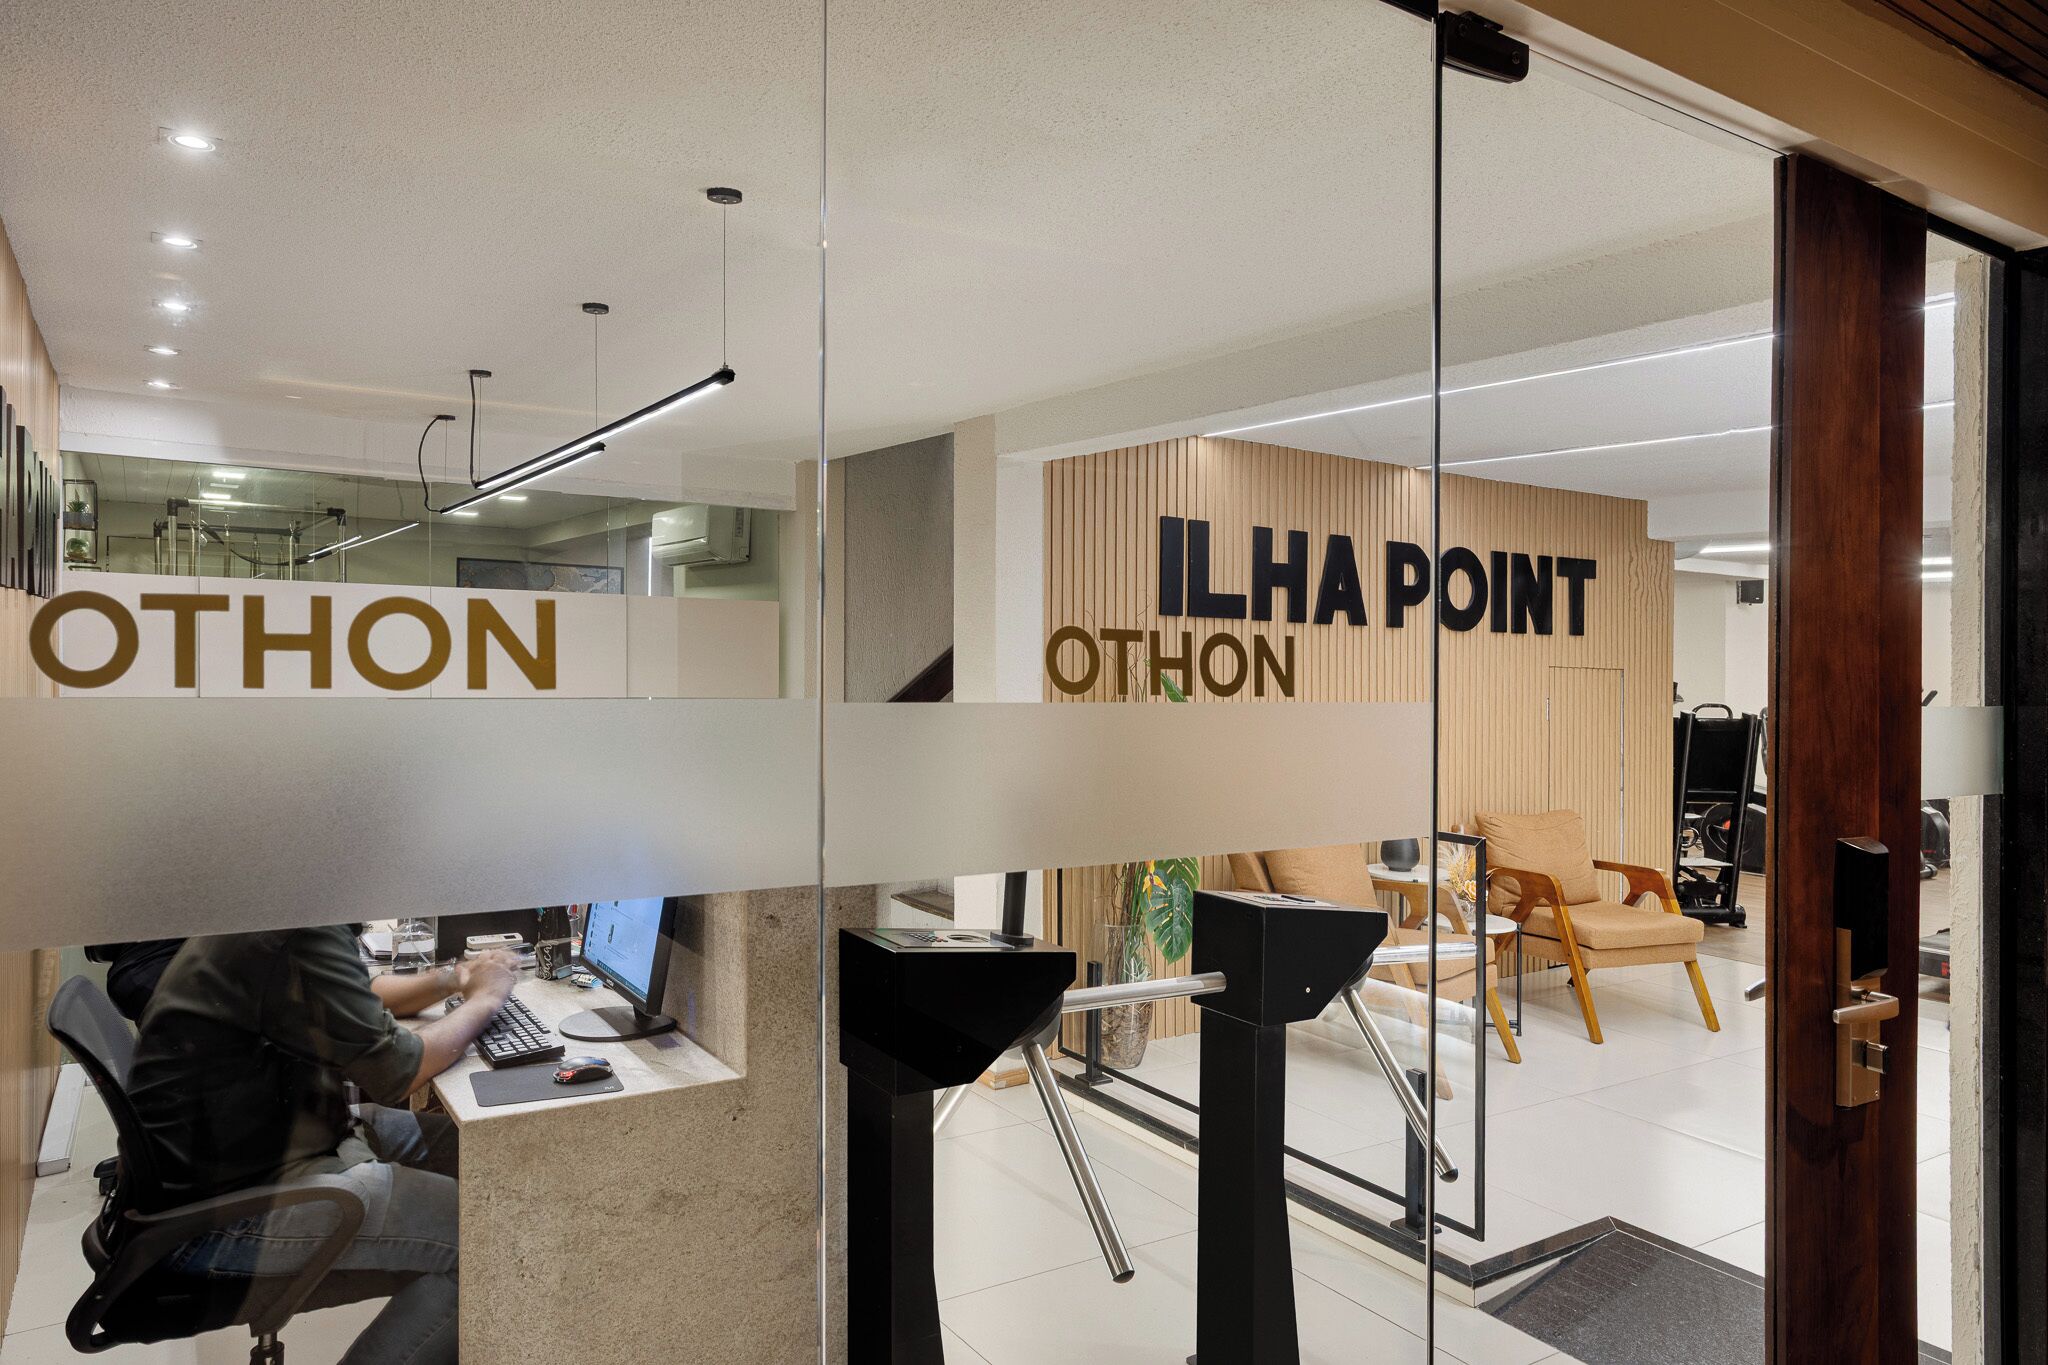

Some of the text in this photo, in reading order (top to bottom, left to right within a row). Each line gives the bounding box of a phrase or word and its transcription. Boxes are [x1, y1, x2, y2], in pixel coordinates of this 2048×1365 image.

[1158, 515, 1597, 637] ILHA POINT
[29, 589, 557, 690] OTHON
[1045, 625, 1296, 698] OTHON
